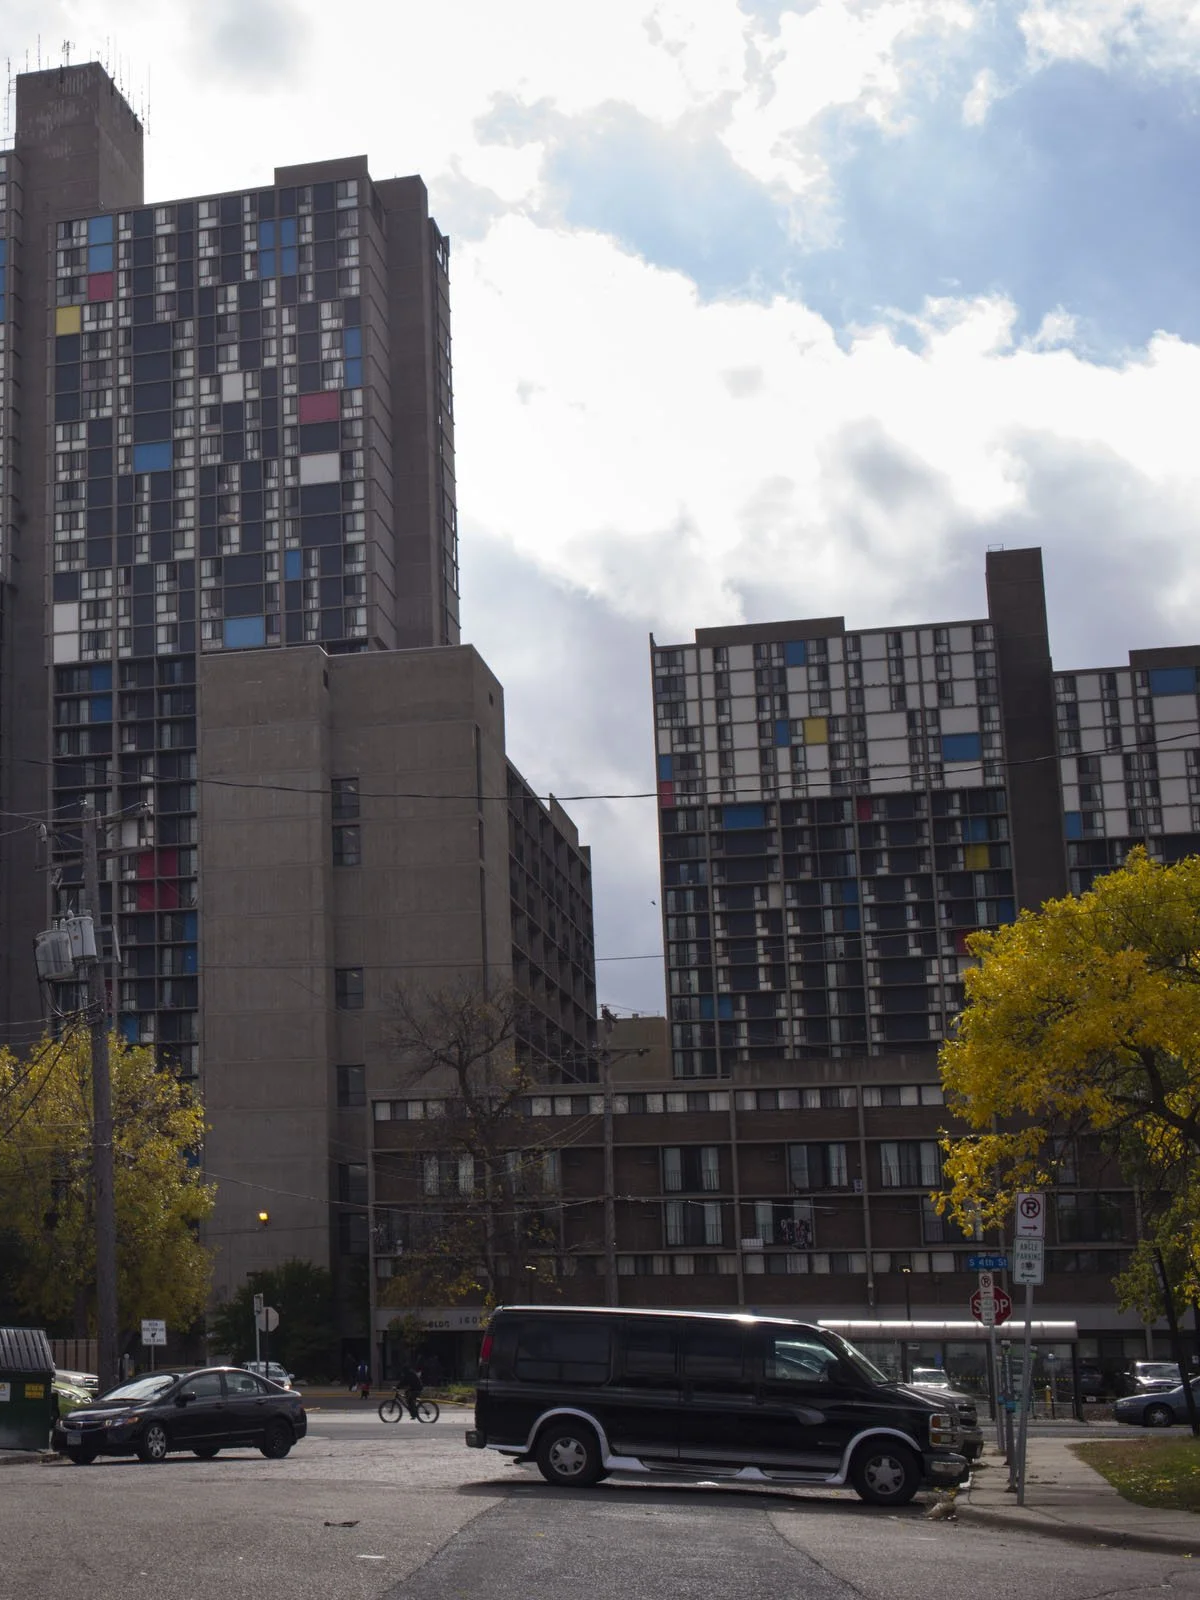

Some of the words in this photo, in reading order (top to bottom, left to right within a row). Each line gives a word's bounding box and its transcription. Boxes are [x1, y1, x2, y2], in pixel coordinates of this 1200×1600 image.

[1020, 1242, 1038, 1252] ANGLE
[1016, 1252, 1041, 1261] PARKING
[969, 1259, 975, 1267] S
[978, 1259, 994, 1267] 4th
[998, 1259, 1008, 1267] St
[973, 1299, 1009, 1314] SOP
[429, 1320, 450, 1329] BLDG
